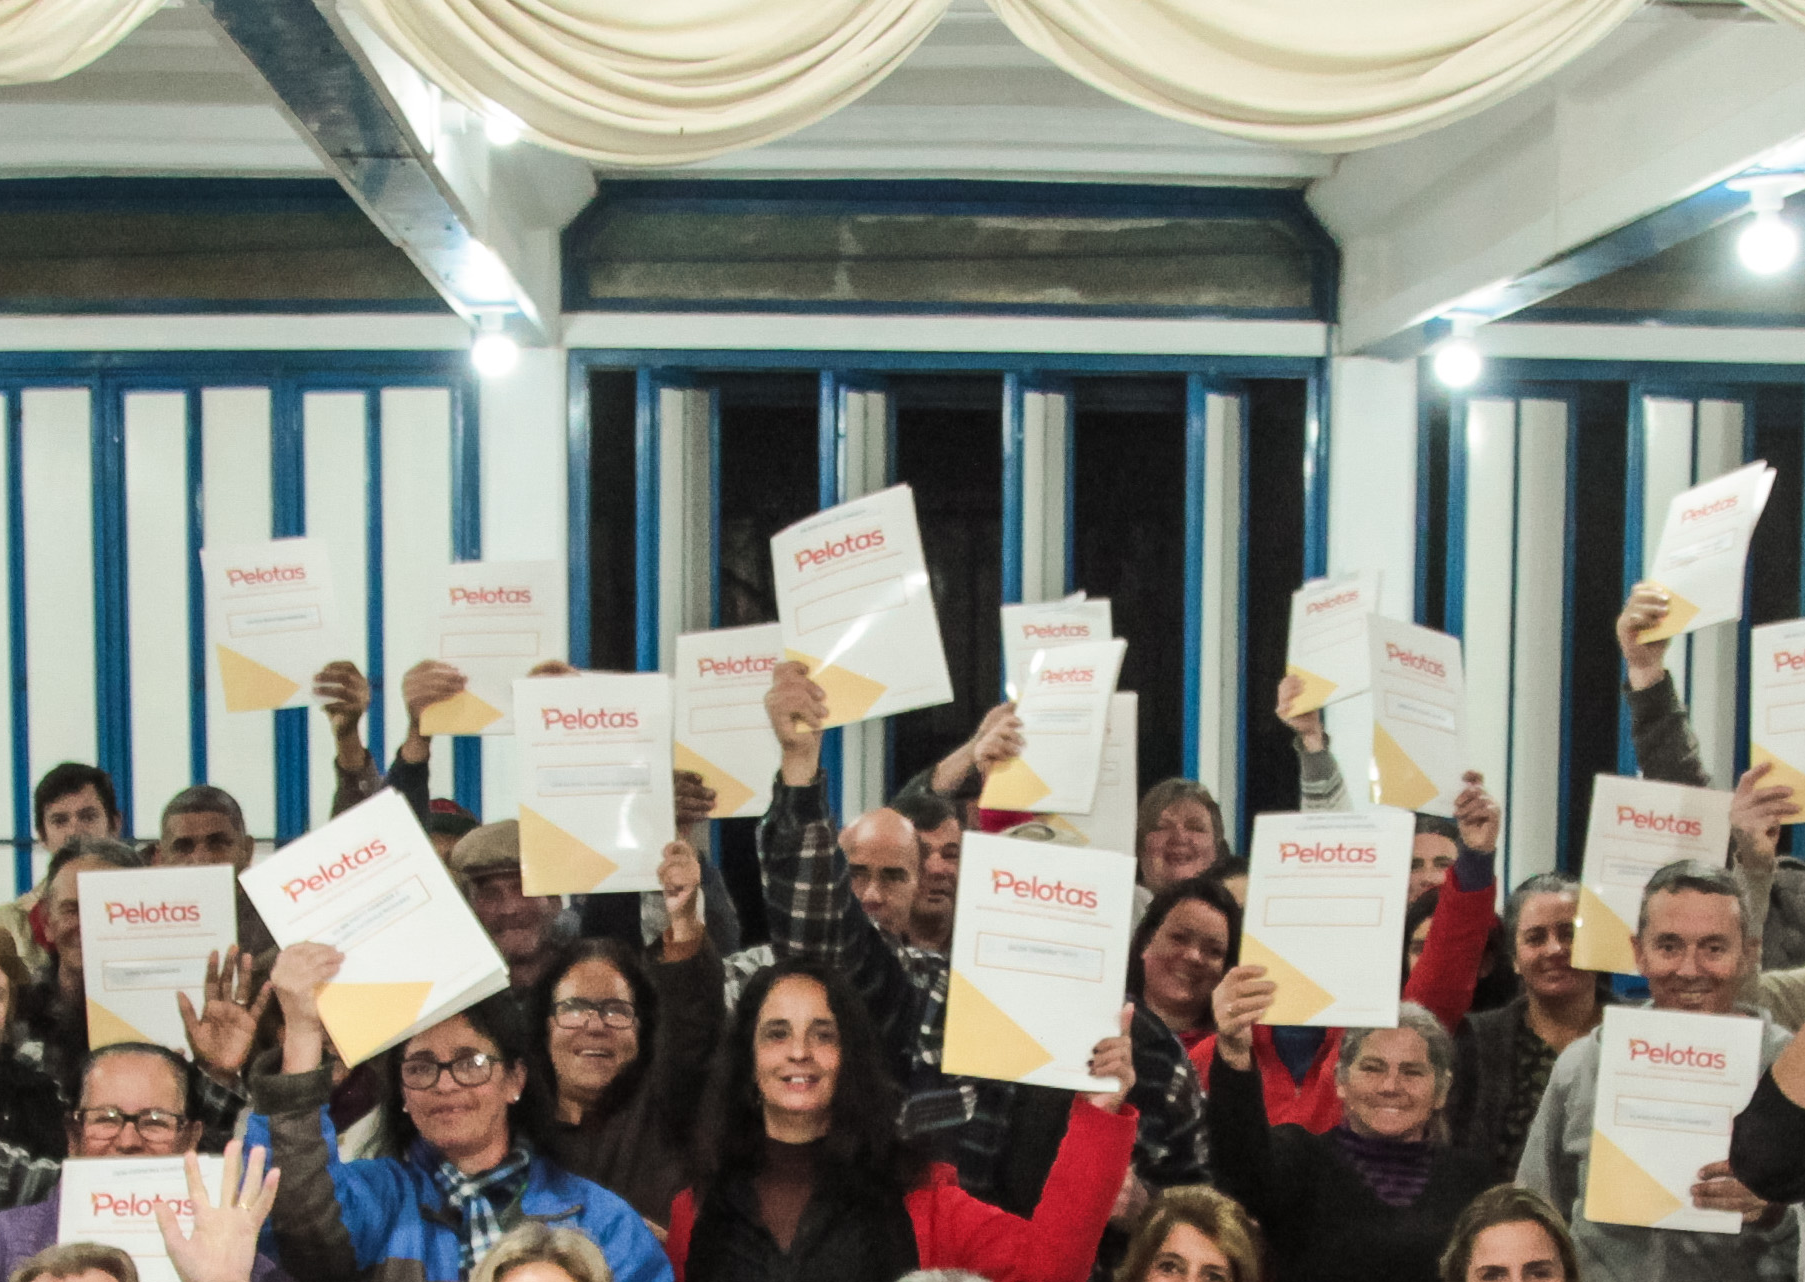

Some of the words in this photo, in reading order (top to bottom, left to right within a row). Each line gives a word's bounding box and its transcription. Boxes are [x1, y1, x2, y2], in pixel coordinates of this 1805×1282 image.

[794, 528, 885, 571] Pelotas
[226, 566, 306, 587] Pelotas
[450, 586, 532, 605] Pelotas
[698, 655, 778, 677] Pelotas
[1385, 642, 1445, 678] Pelotas
[541, 707, 639, 730] Pelotas
[1616, 805, 1702, 836] Pelotas
[1279, 842, 1377, 863] Pelotas
[280, 839, 387, 903] Pelotas
[991, 869, 1097, 909] Pelotas
[105, 902, 201, 924] Pelotas
[1629, 1038, 1727, 1070] Pelotas
